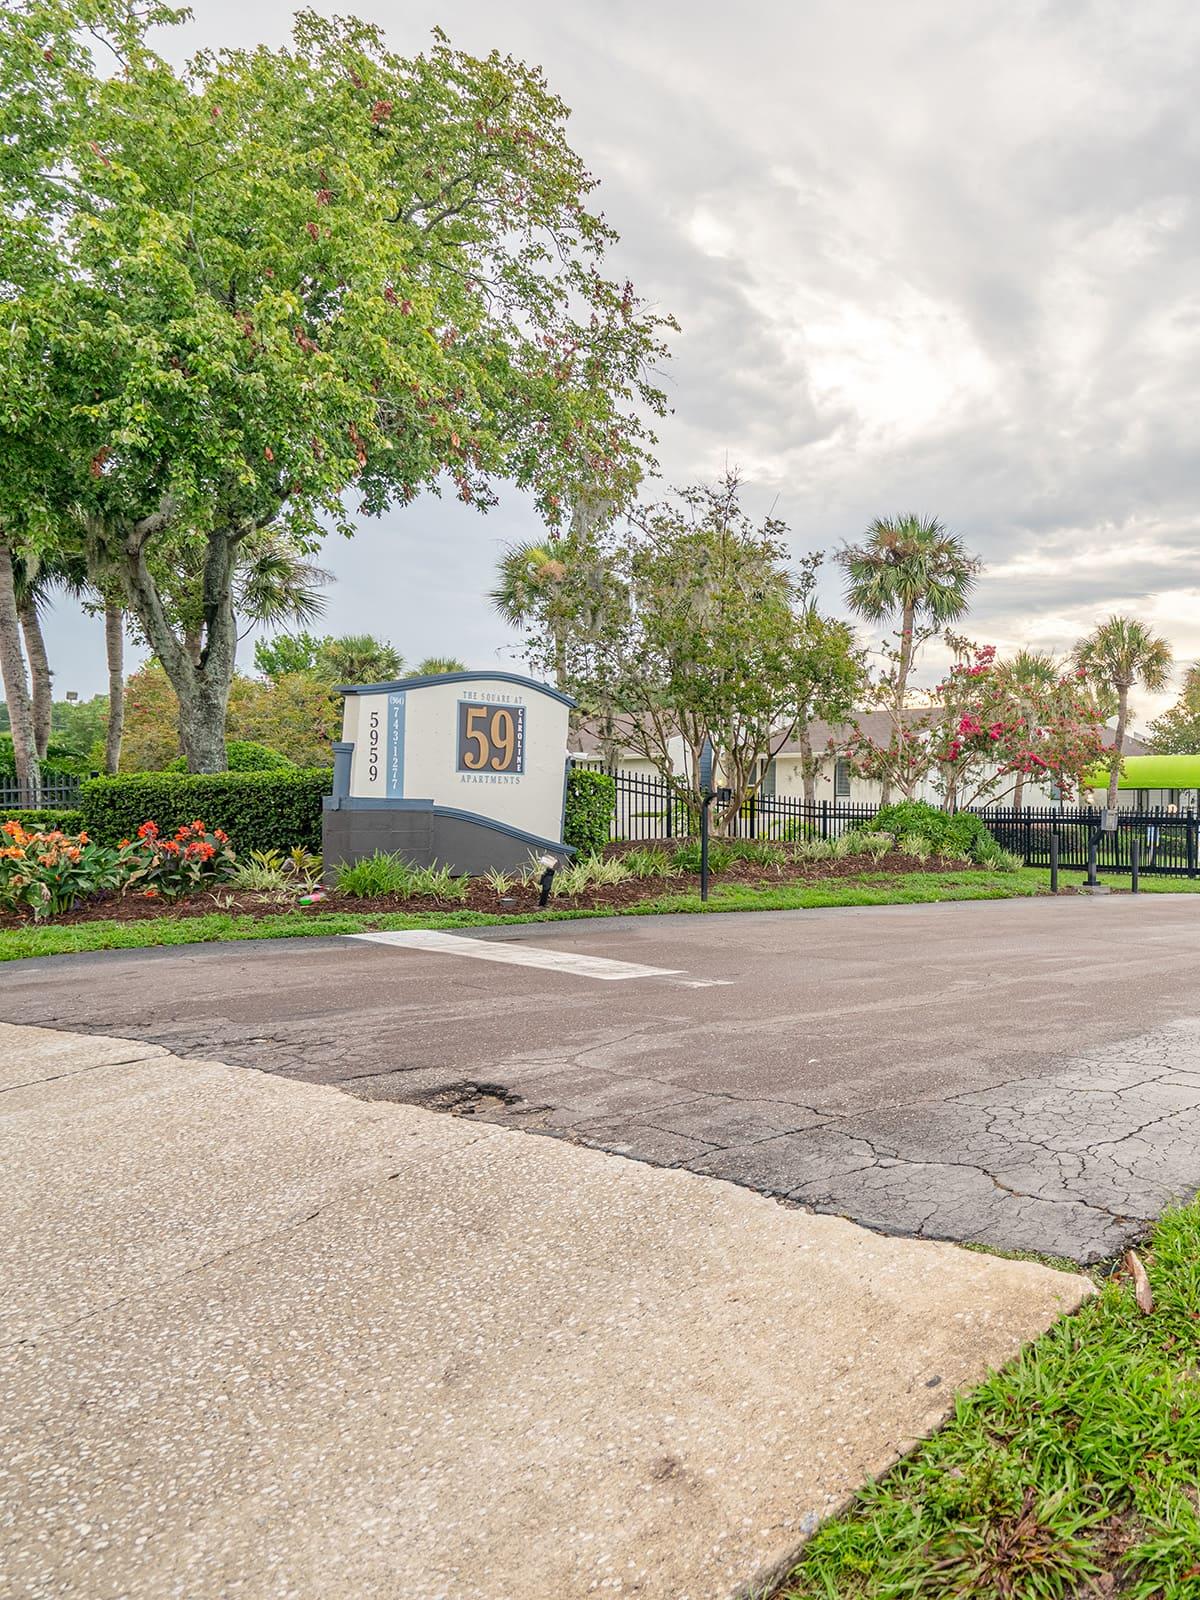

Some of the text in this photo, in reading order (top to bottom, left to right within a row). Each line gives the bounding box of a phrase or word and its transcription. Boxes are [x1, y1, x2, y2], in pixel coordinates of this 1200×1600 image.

[463, 690, 523, 704] THE SQUARE AT
[369, 711, 379, 782] 5959
[464, 706, 515, 771] 59
[460, 774, 521, 785] APARTMENTS
